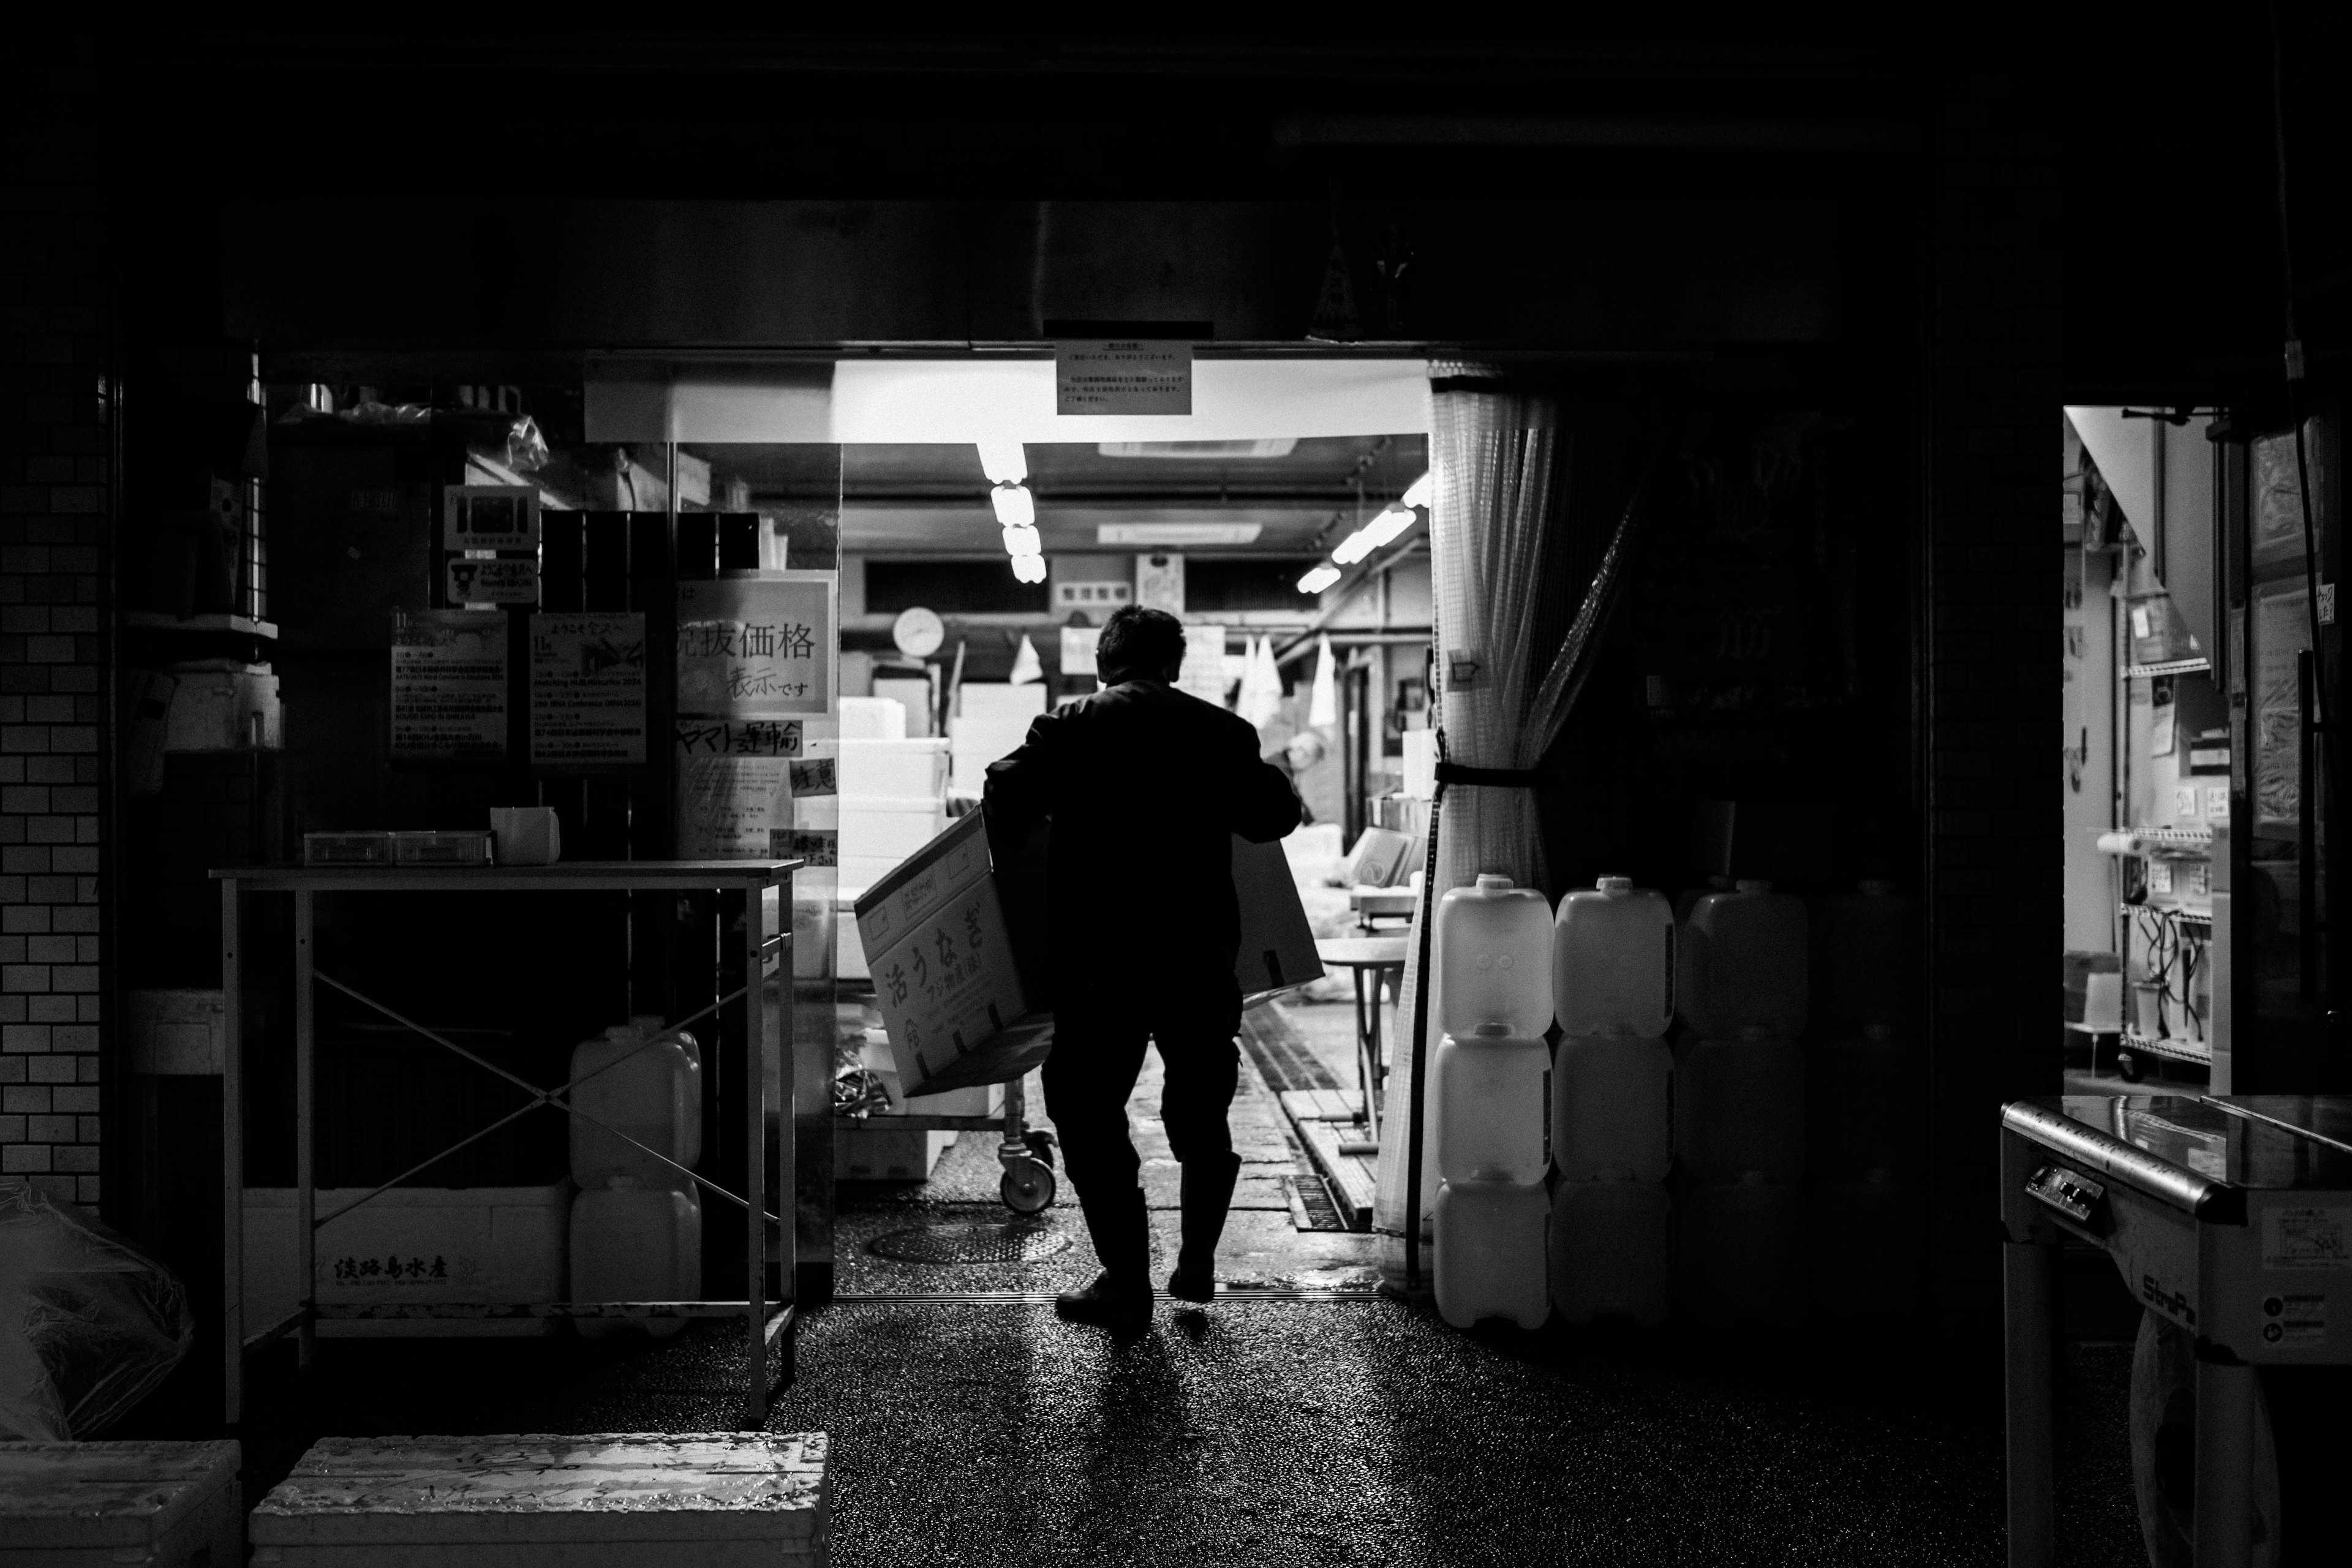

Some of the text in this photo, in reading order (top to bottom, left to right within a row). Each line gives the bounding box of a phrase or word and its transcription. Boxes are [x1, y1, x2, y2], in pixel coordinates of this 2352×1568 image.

[534, 679, 568, 688] Matching
[674, 722, 797, 755] ヤマト運輸
[885, 901, 983, 1008] 活うなぎ
[334, 1254, 448, 1279] 淡路島水産
